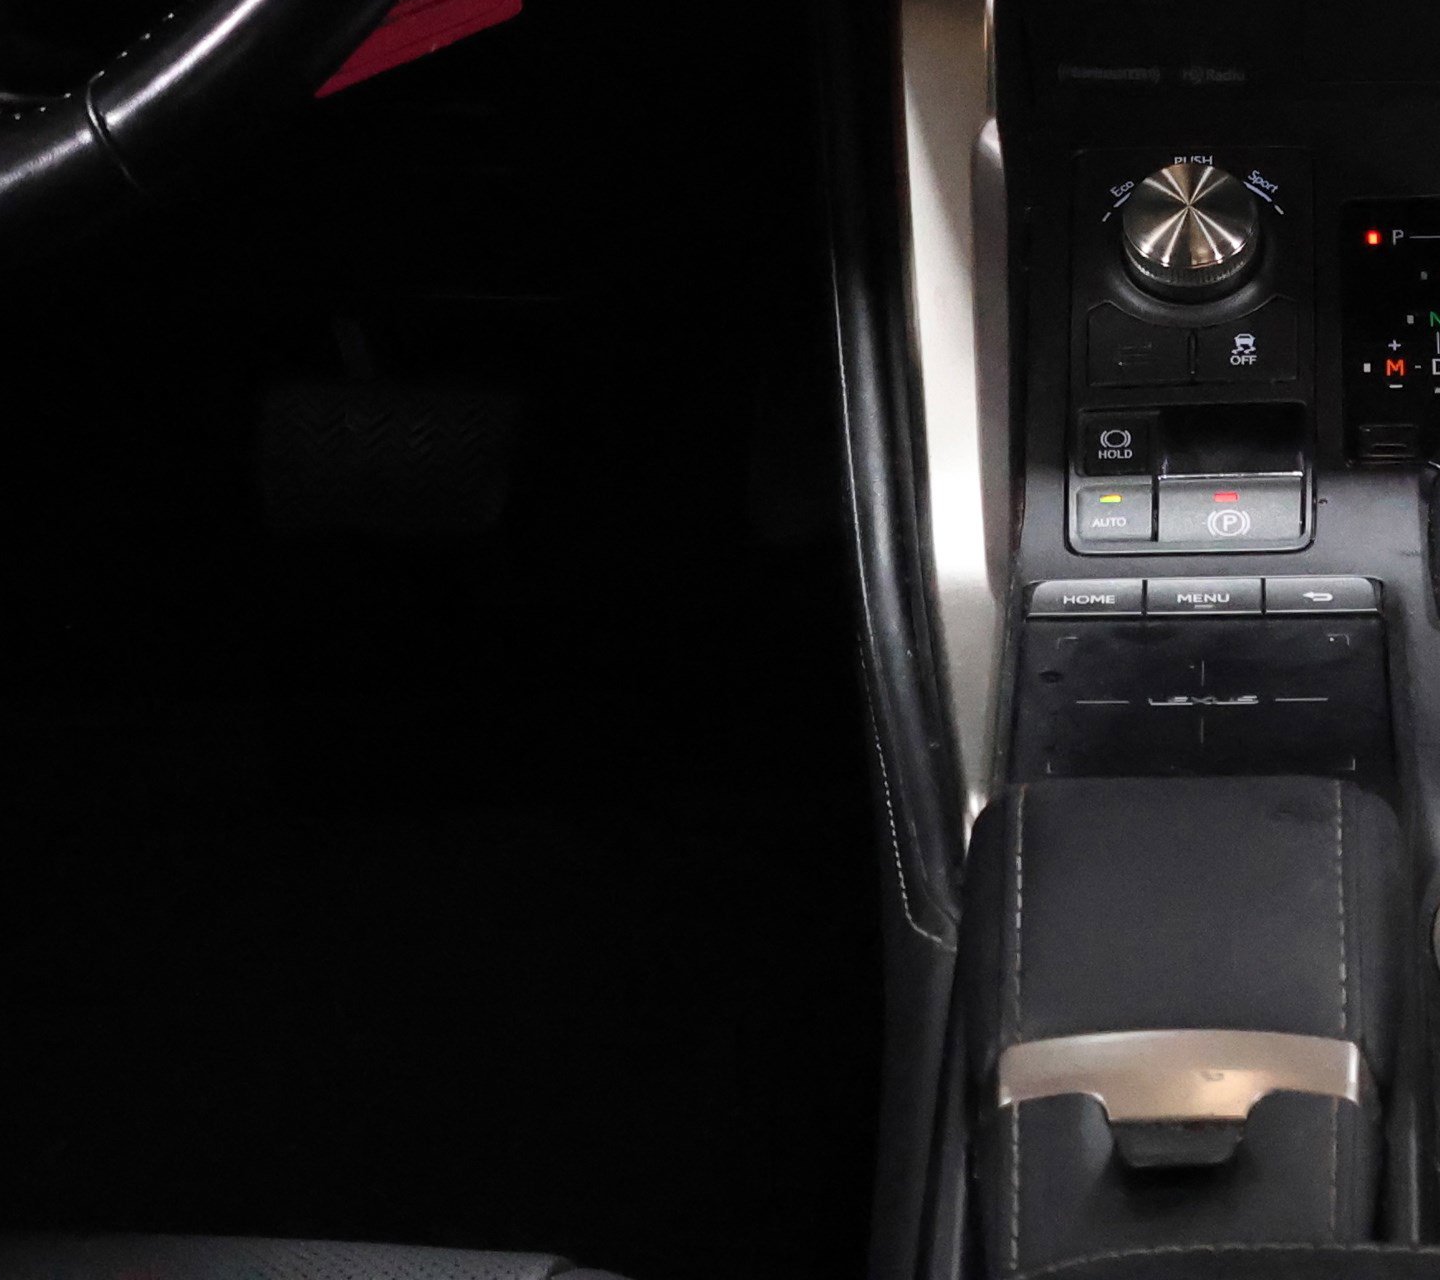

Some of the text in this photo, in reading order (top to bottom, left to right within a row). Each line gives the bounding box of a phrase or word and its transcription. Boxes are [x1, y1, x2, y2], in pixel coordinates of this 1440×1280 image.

[1110, 179, 1134, 198] Eco
[1247, 169, 1281, 195] Sport
[1393, 230, 1403, 245] P
[1230, 352, 1257, 365] OFF
[1387, 360, 1403, 376] M
[1099, 446, 1132, 459] HOLD
[1092, 517, 1127, 527] AUTO
[1062, 593, 1115, 605] HOME
[1176, 592, 1231, 604] MENU
